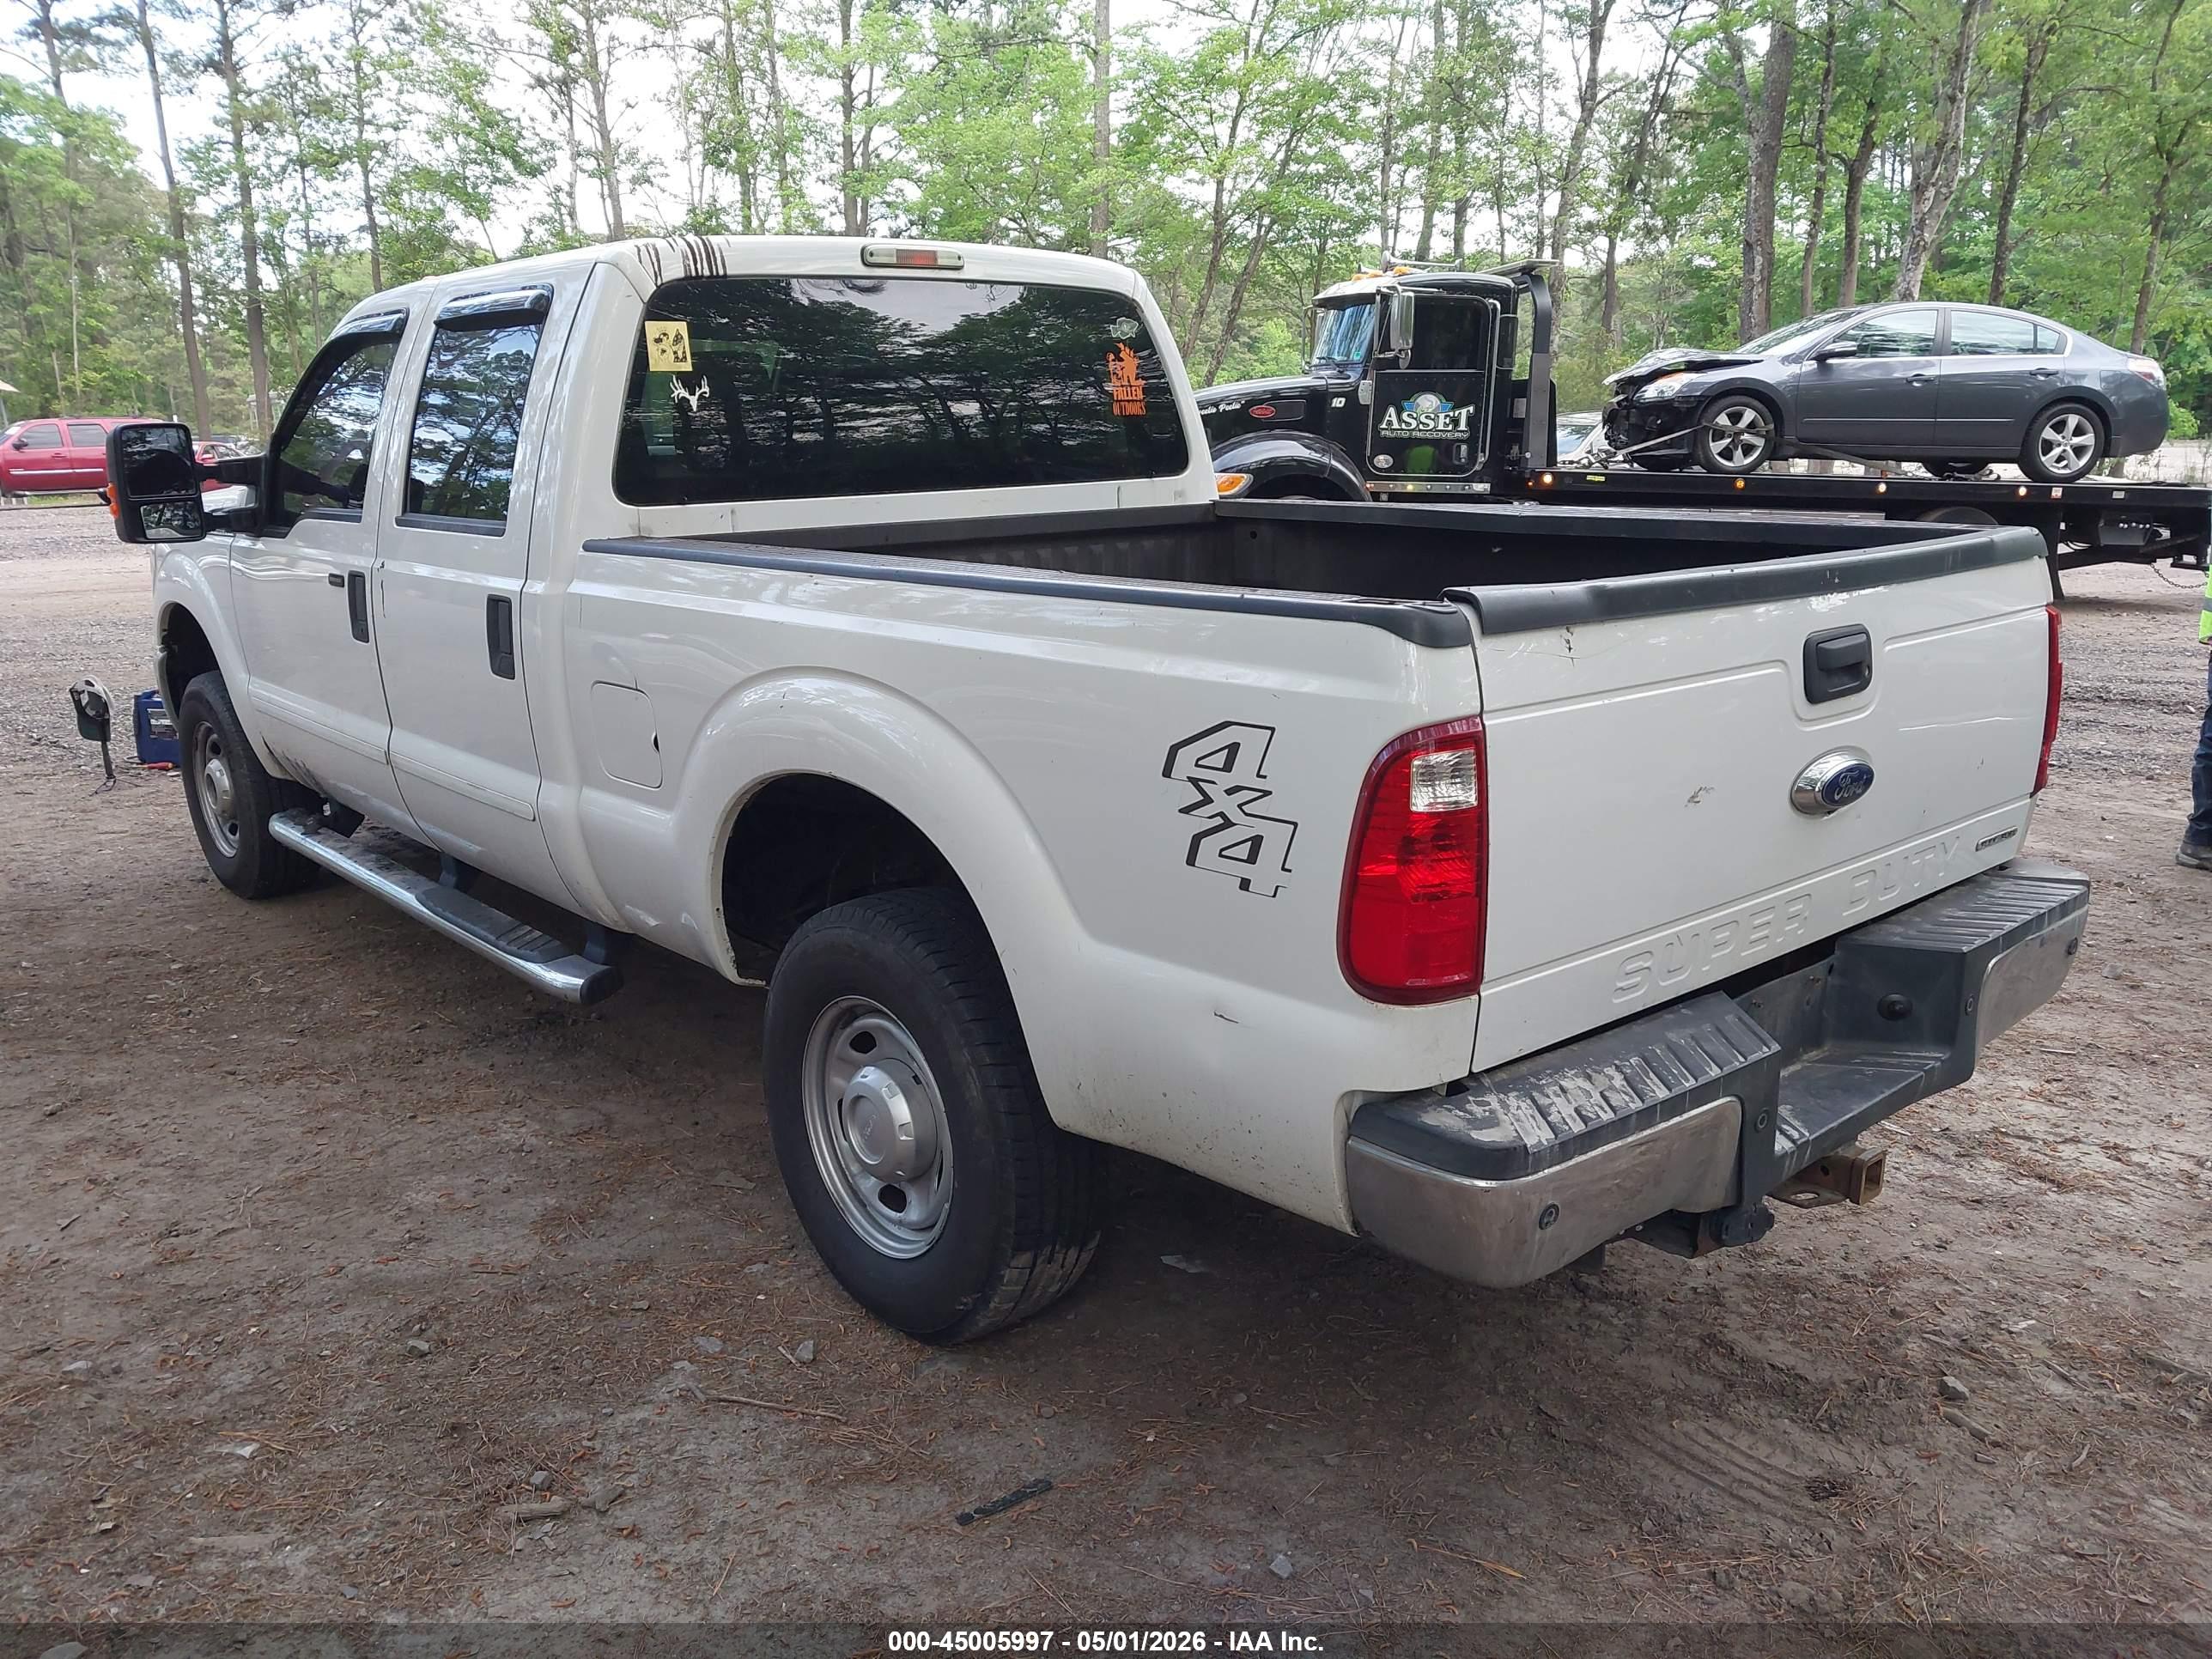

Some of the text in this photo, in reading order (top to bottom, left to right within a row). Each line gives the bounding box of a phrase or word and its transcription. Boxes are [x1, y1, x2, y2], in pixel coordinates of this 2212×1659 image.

[1113, 386, 1143, 400] FALLEN
[1113, 401, 1146, 416] OUTDOORS
[1331, 398, 1346, 408] 10
[1379, 405, 1474, 431] ASSET
[1413, 430, 1469, 439] RECOVERY
[1834, 769, 1869, 800] Ford
[1612, 836, 1960, 1005] SUPER DUTY
